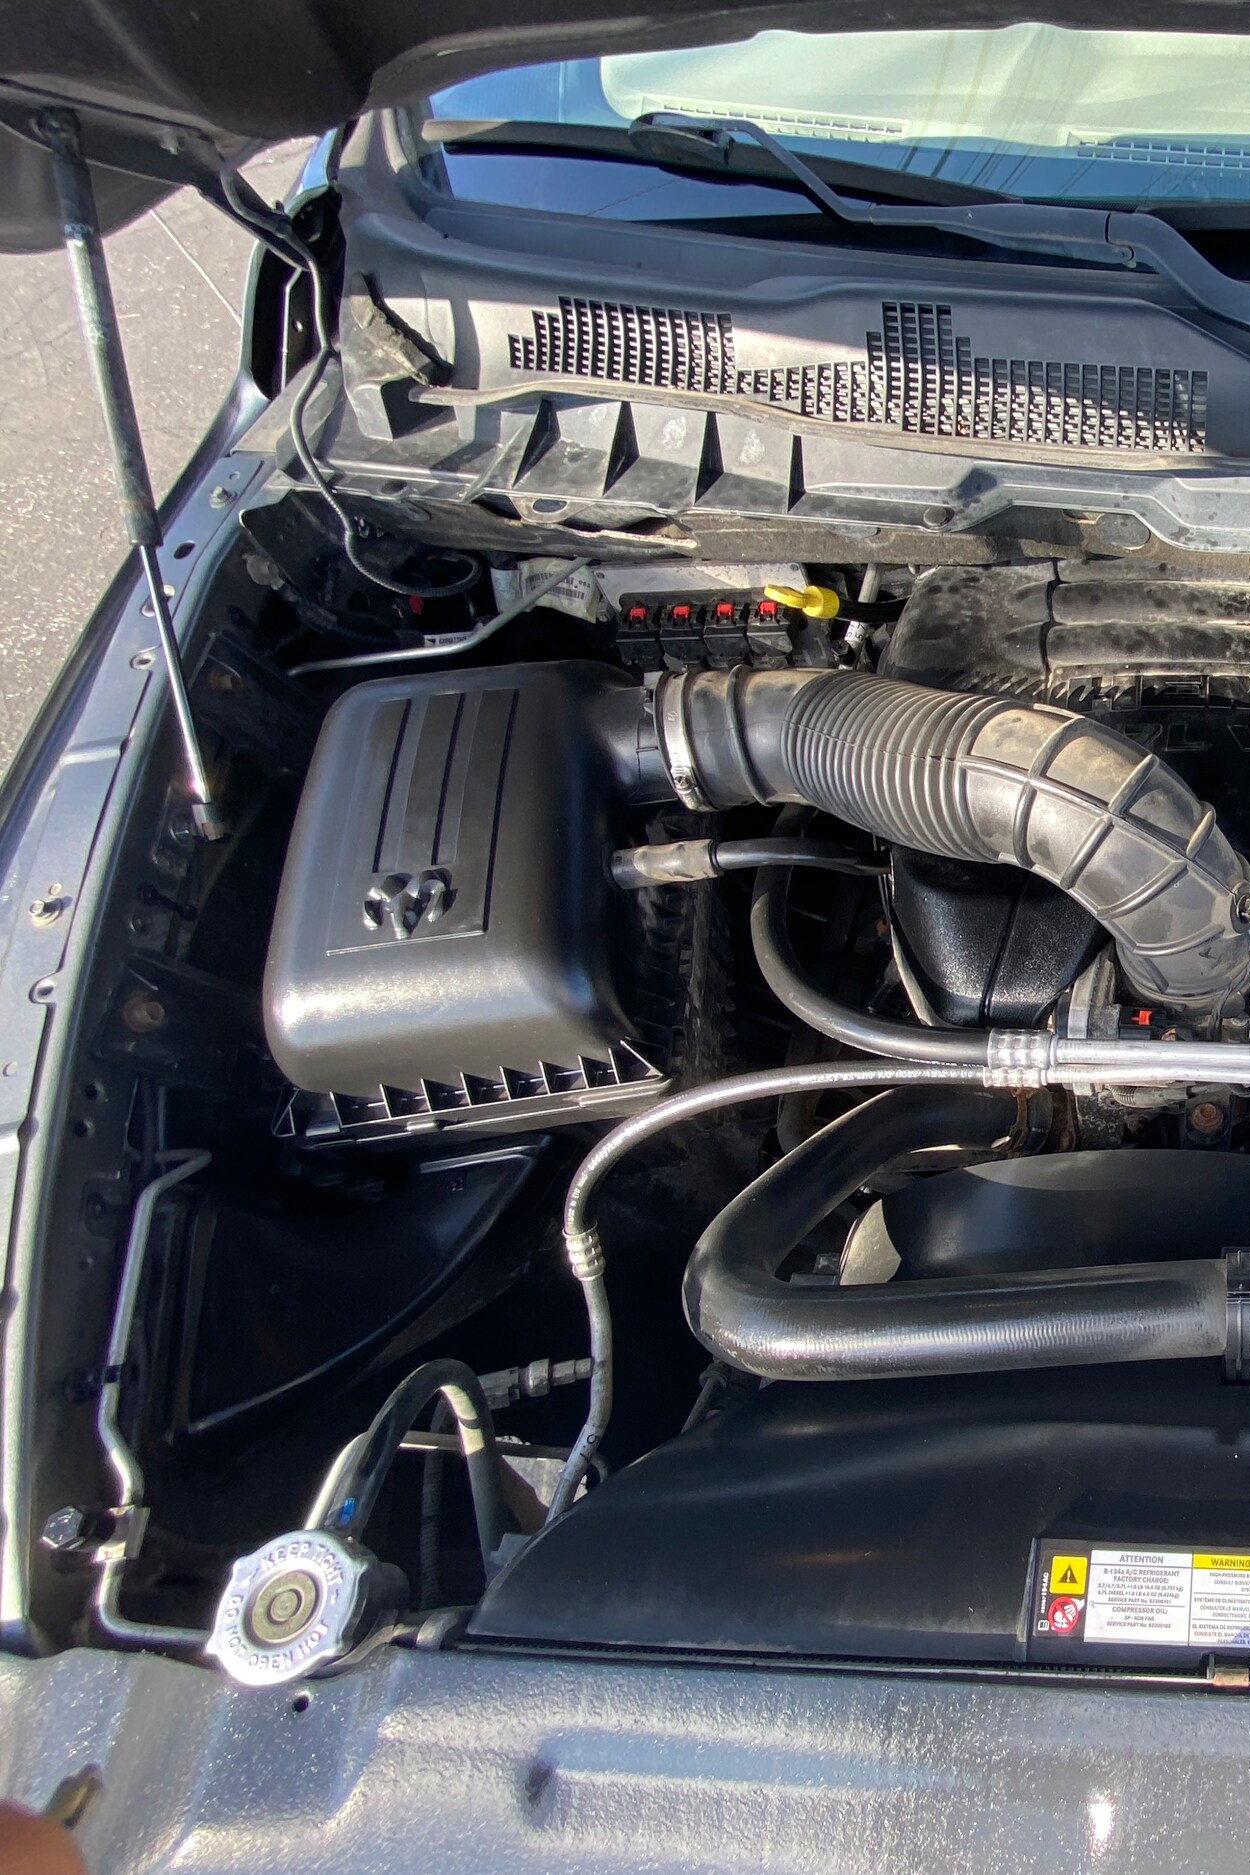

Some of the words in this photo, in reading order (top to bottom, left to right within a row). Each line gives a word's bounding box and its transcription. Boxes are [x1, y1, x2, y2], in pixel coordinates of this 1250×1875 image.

[260, 1541, 311, 1571] KEEP
[312, 1543, 345, 1585] TIGHT
[1119, 1555, 1164, 1563] ATTENTION
[1211, 1558, 1250, 1567] WARNING
[224, 1593, 245, 1620] DO
[1112, 1606, 1155, 1614] COMPRESSOR
[1038, 1619, 1049, 1631] B
